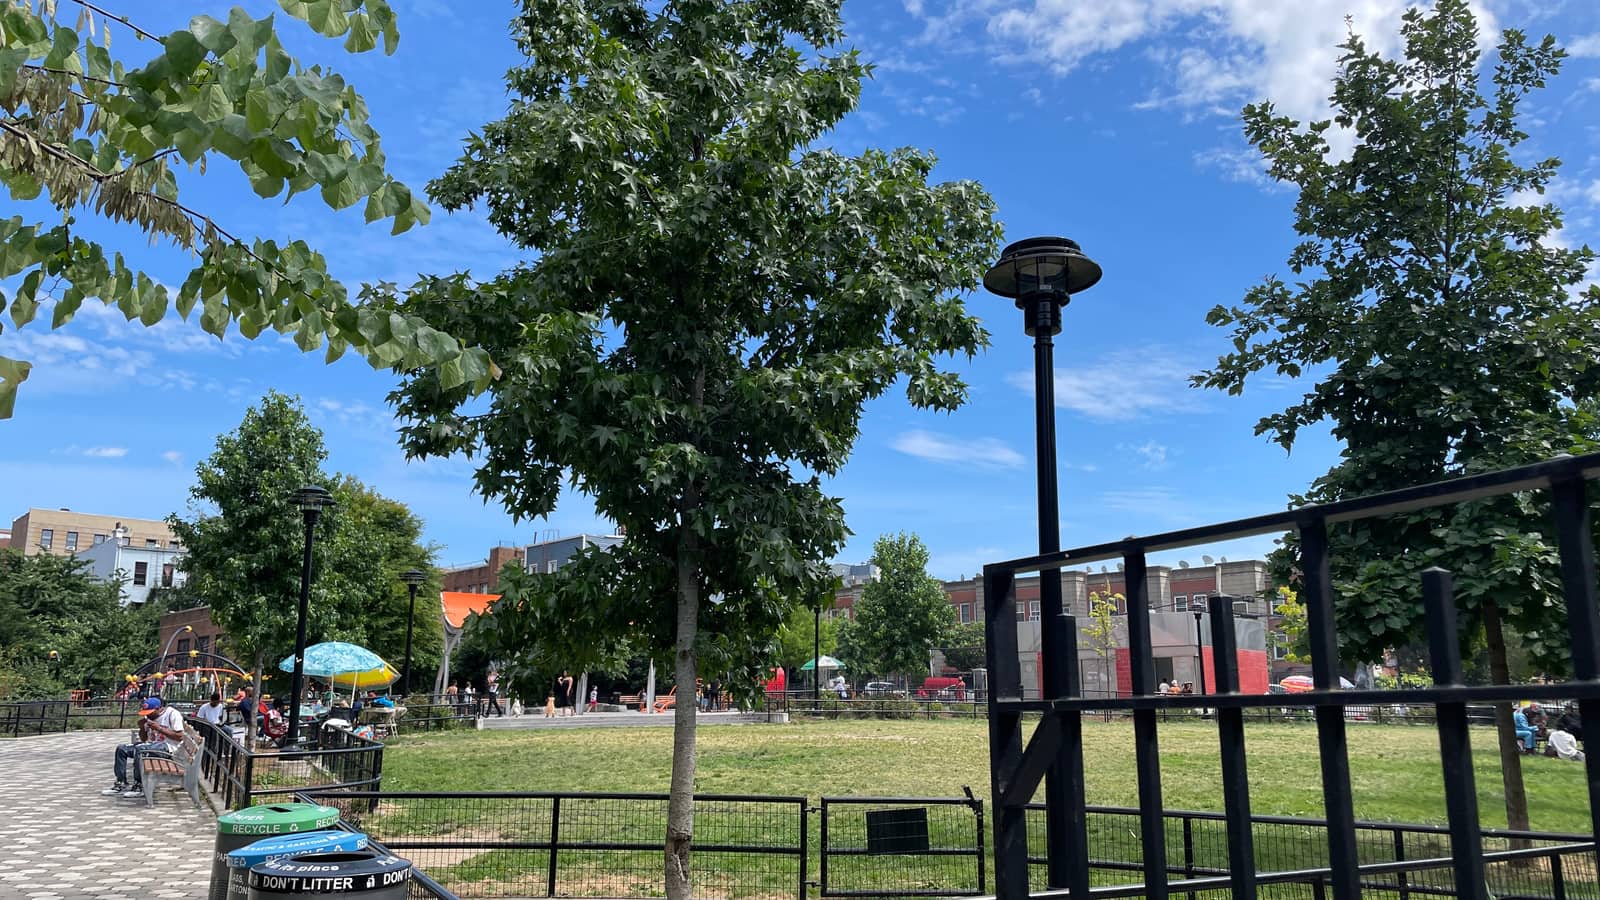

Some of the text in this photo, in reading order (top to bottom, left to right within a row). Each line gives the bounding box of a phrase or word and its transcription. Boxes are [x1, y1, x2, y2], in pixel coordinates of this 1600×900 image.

[232, 824, 281, 833] RECYCLE
[296, 865, 339, 873] place
[263, 877, 353, 891] DON'T LITTER
